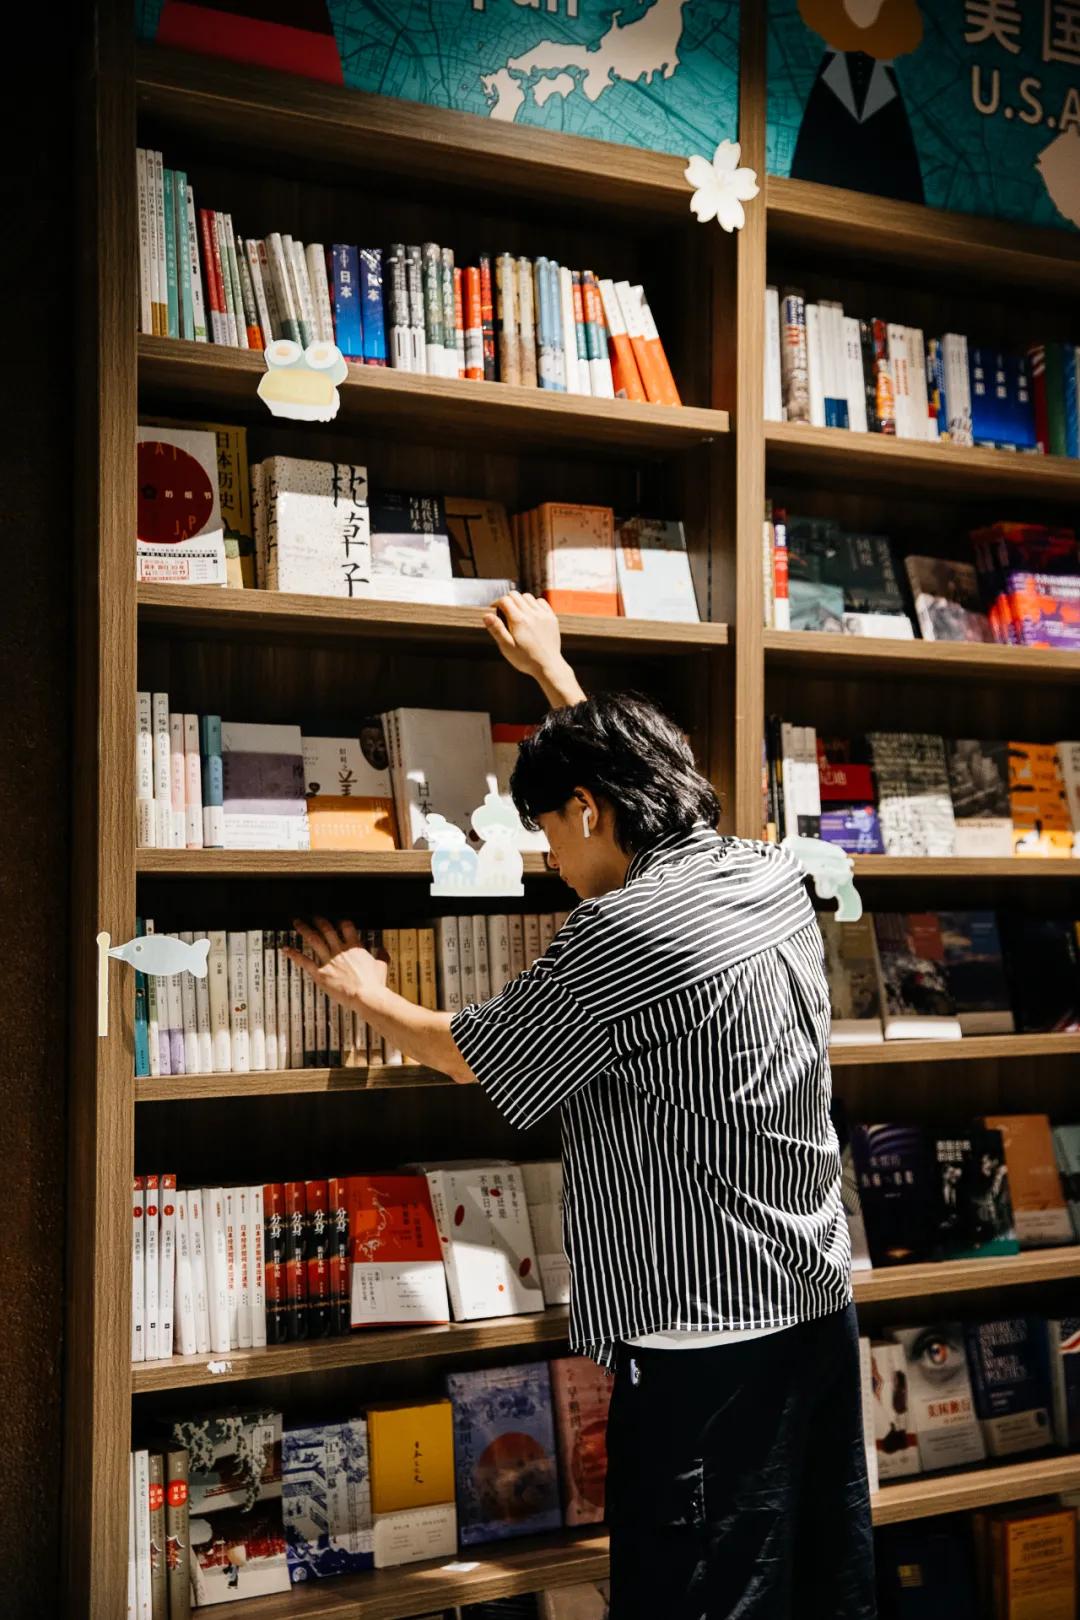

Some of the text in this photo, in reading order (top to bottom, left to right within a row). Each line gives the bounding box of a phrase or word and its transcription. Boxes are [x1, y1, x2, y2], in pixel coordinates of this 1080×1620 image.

[964, 0, 1080, 64] 美国
[340, 270, 352, 299] 日本
[216, 431, 234, 511] 日本历史
[331, 463, 370, 597] 枕草子
